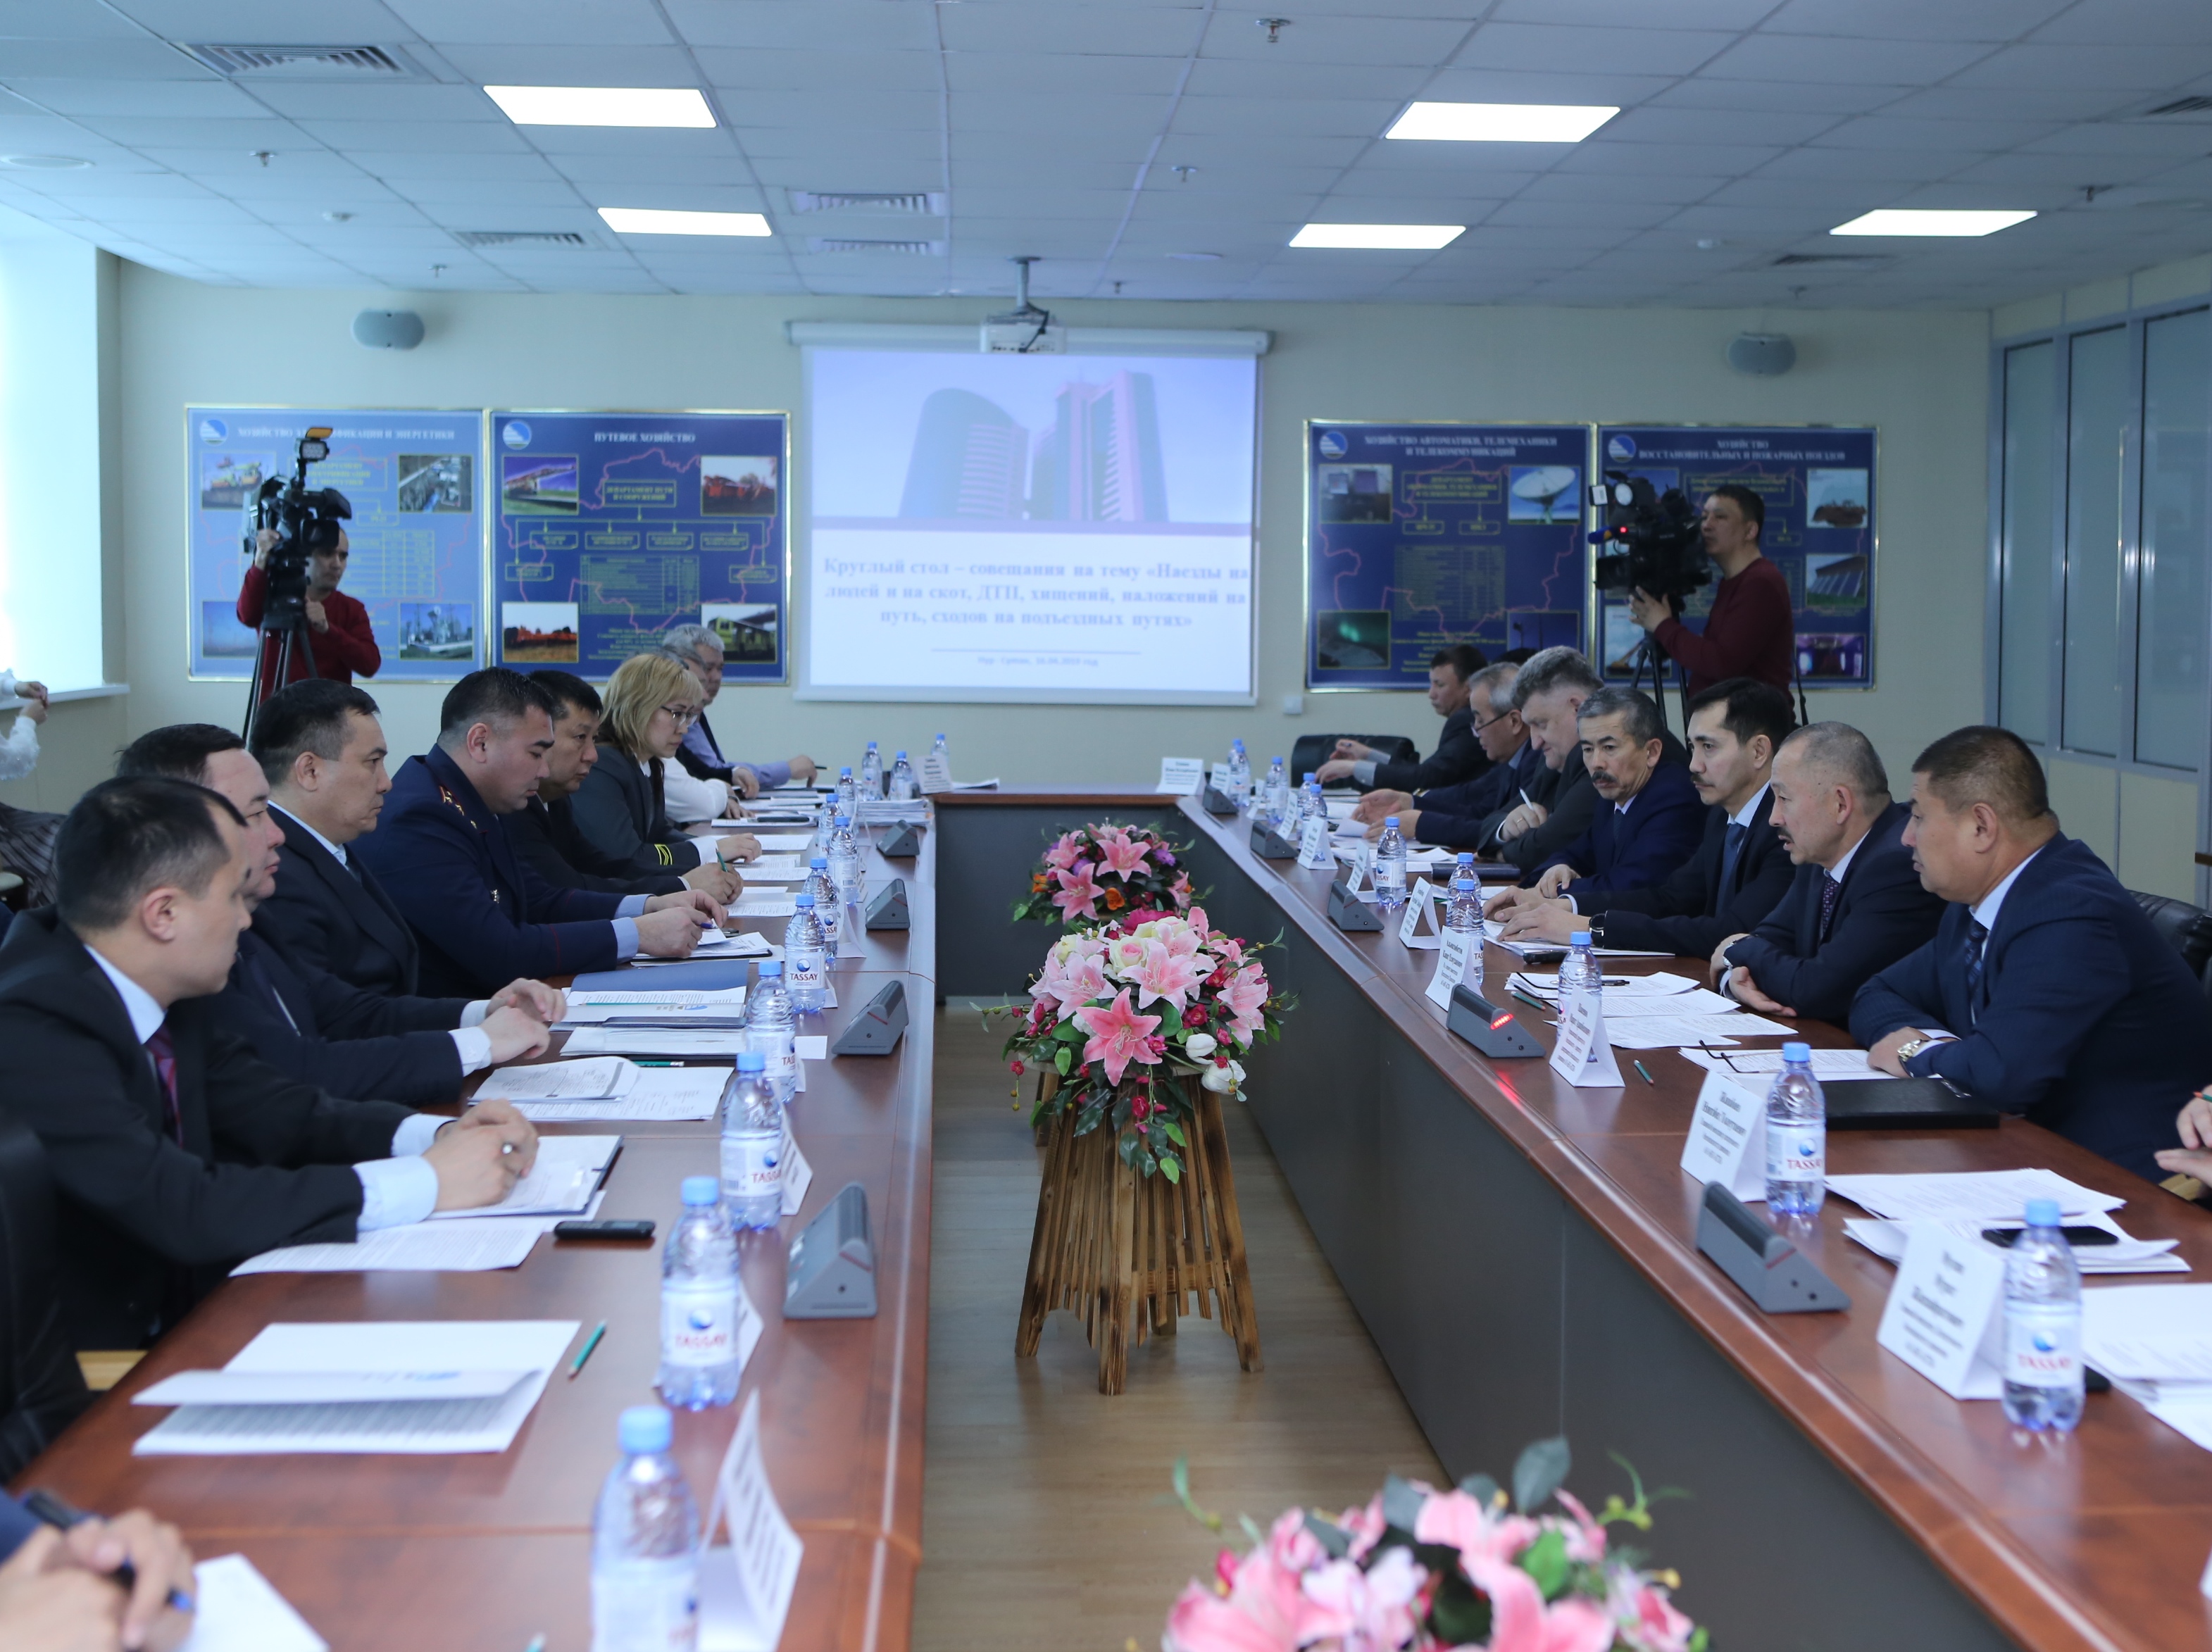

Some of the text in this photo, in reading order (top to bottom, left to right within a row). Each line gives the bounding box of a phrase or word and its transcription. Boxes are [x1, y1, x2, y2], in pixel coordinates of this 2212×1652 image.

[824, 558, 905, 577] Круглый
[911, 563, 949, 574] стол
[1074, 565, 1094, 577] на
[1100, 565, 1140, 581] тему
[825, 583, 879, 599] людей
[887, 587, 896, 598] и
[903, 587, 923, 598] на
[929, 587, 972, 601] скот,
[977, 584, 1025, 601] ДТП,
[1122, 589, 1218, 603] наложений
[1226, 592, 1246, 603] на
[994, 613, 1015, 624] на
[789, 972, 818, 981] TASSAY
[1787, 1158, 1822, 1170] TASSA
[751, 1170, 782, 1184] TASSA
